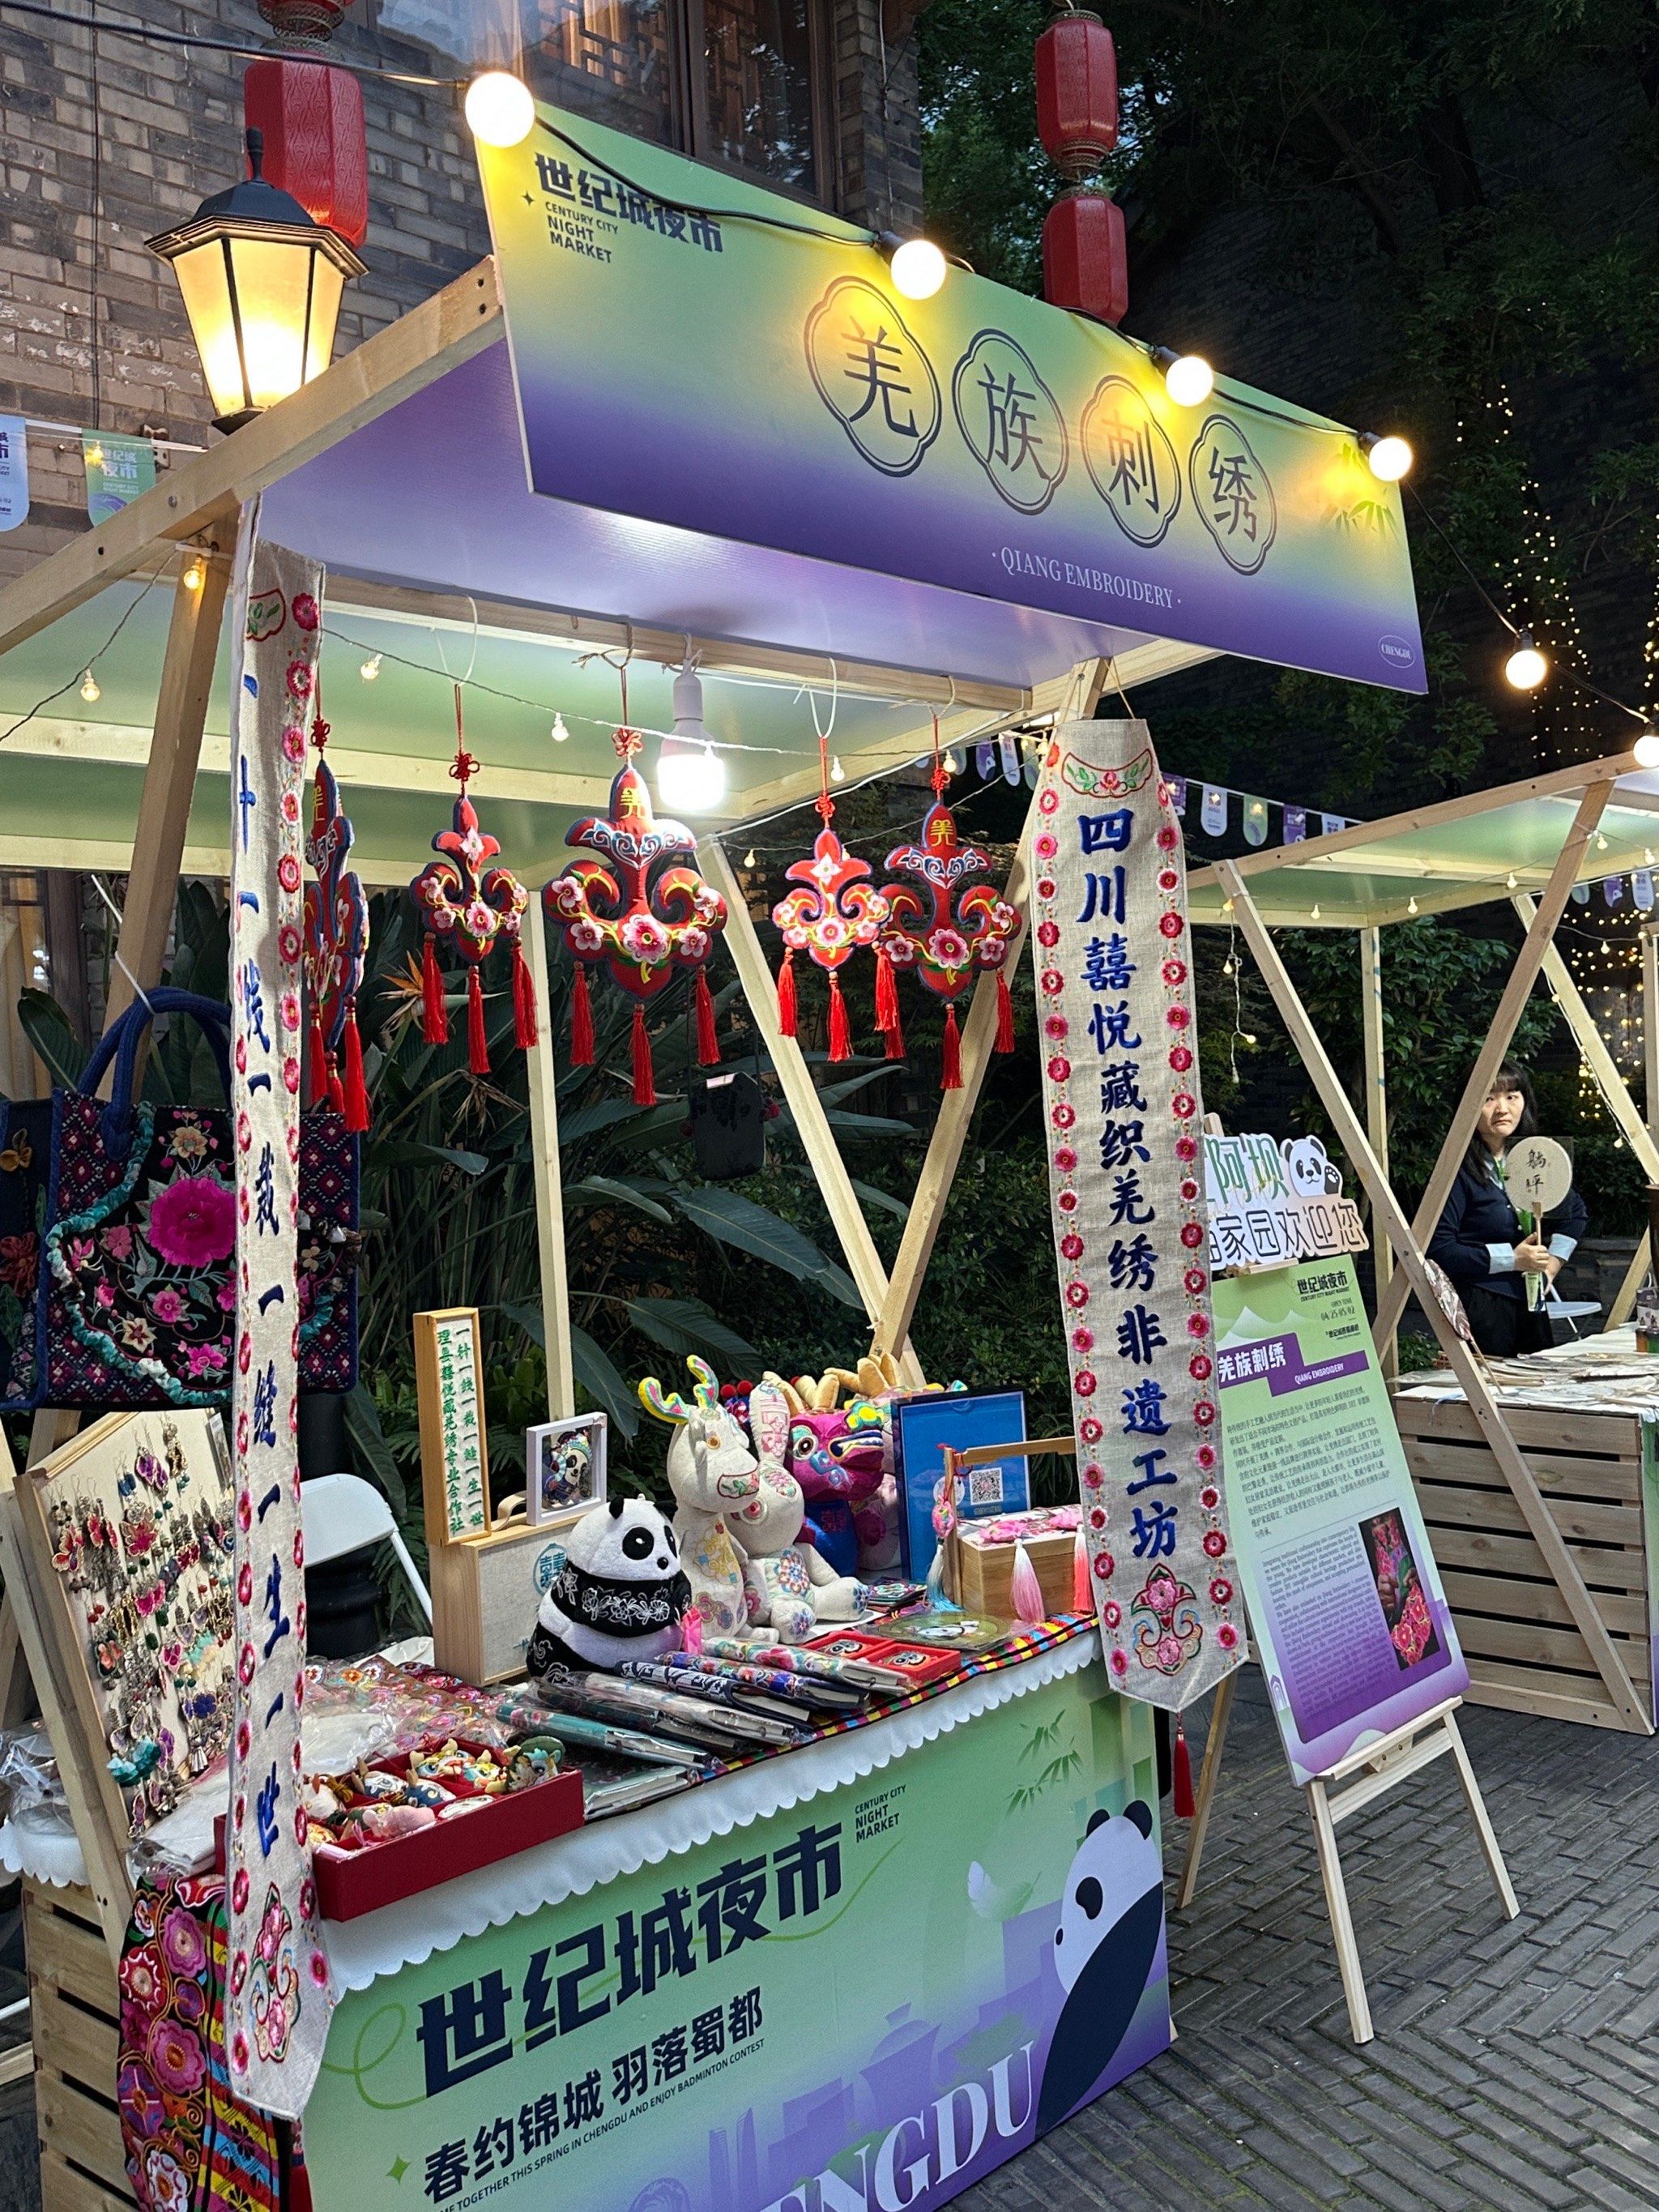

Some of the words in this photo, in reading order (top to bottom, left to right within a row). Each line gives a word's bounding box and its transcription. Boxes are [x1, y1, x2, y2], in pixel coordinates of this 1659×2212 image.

[535, 152, 723, 253] 世纪城夜市
[545, 202, 594, 226] CENTURY
[596, 219, 619, 235] CITY
[547, 215, 595, 242] NIGHT
[549, 231, 612, 264] MARKET
[841, 317, 1257, 543] 羌族刺绣
[1000, 546, 1061, 582] QIANG
[1064, 562, 1173, 609] EMBROIDERY
[1205, 1137, 1290, 1205] 阿坝
[1297, 1270, 1348, 1295] 世纪城夜市
[1218, 1342, 1286, 1382] 羌族刺绣
[1294, 1372, 1311, 1385] QIANG
[855, 1791, 889, 1814] CENTURY
[889, 1783, 906, 1798] CITY
[855, 1804, 889, 1830] NIGHT
[855, 1812, 900, 1843] MARKET
[416, 1821, 842, 2098] 世纪城夜市
[424, 2068, 605, 2204] 春约锦城
[611, 1985, 763, 2106] 羽落蜀都
[456, 2176, 510, 2211] TOGETHER
[510, 2163, 534, 2183] THIS
[534, 2145, 570, 2171] SPRING
[571, 2136, 582, 2151] IN
[582, 2111, 629, 2146] CHENGDU
[629, 2100, 649, 2119] AND
[650, 2086, 677, 2108] ENJOY
[677, 2057, 729, 2094] BADMINTON
[729, 2037, 766, 2065] CONTEST
